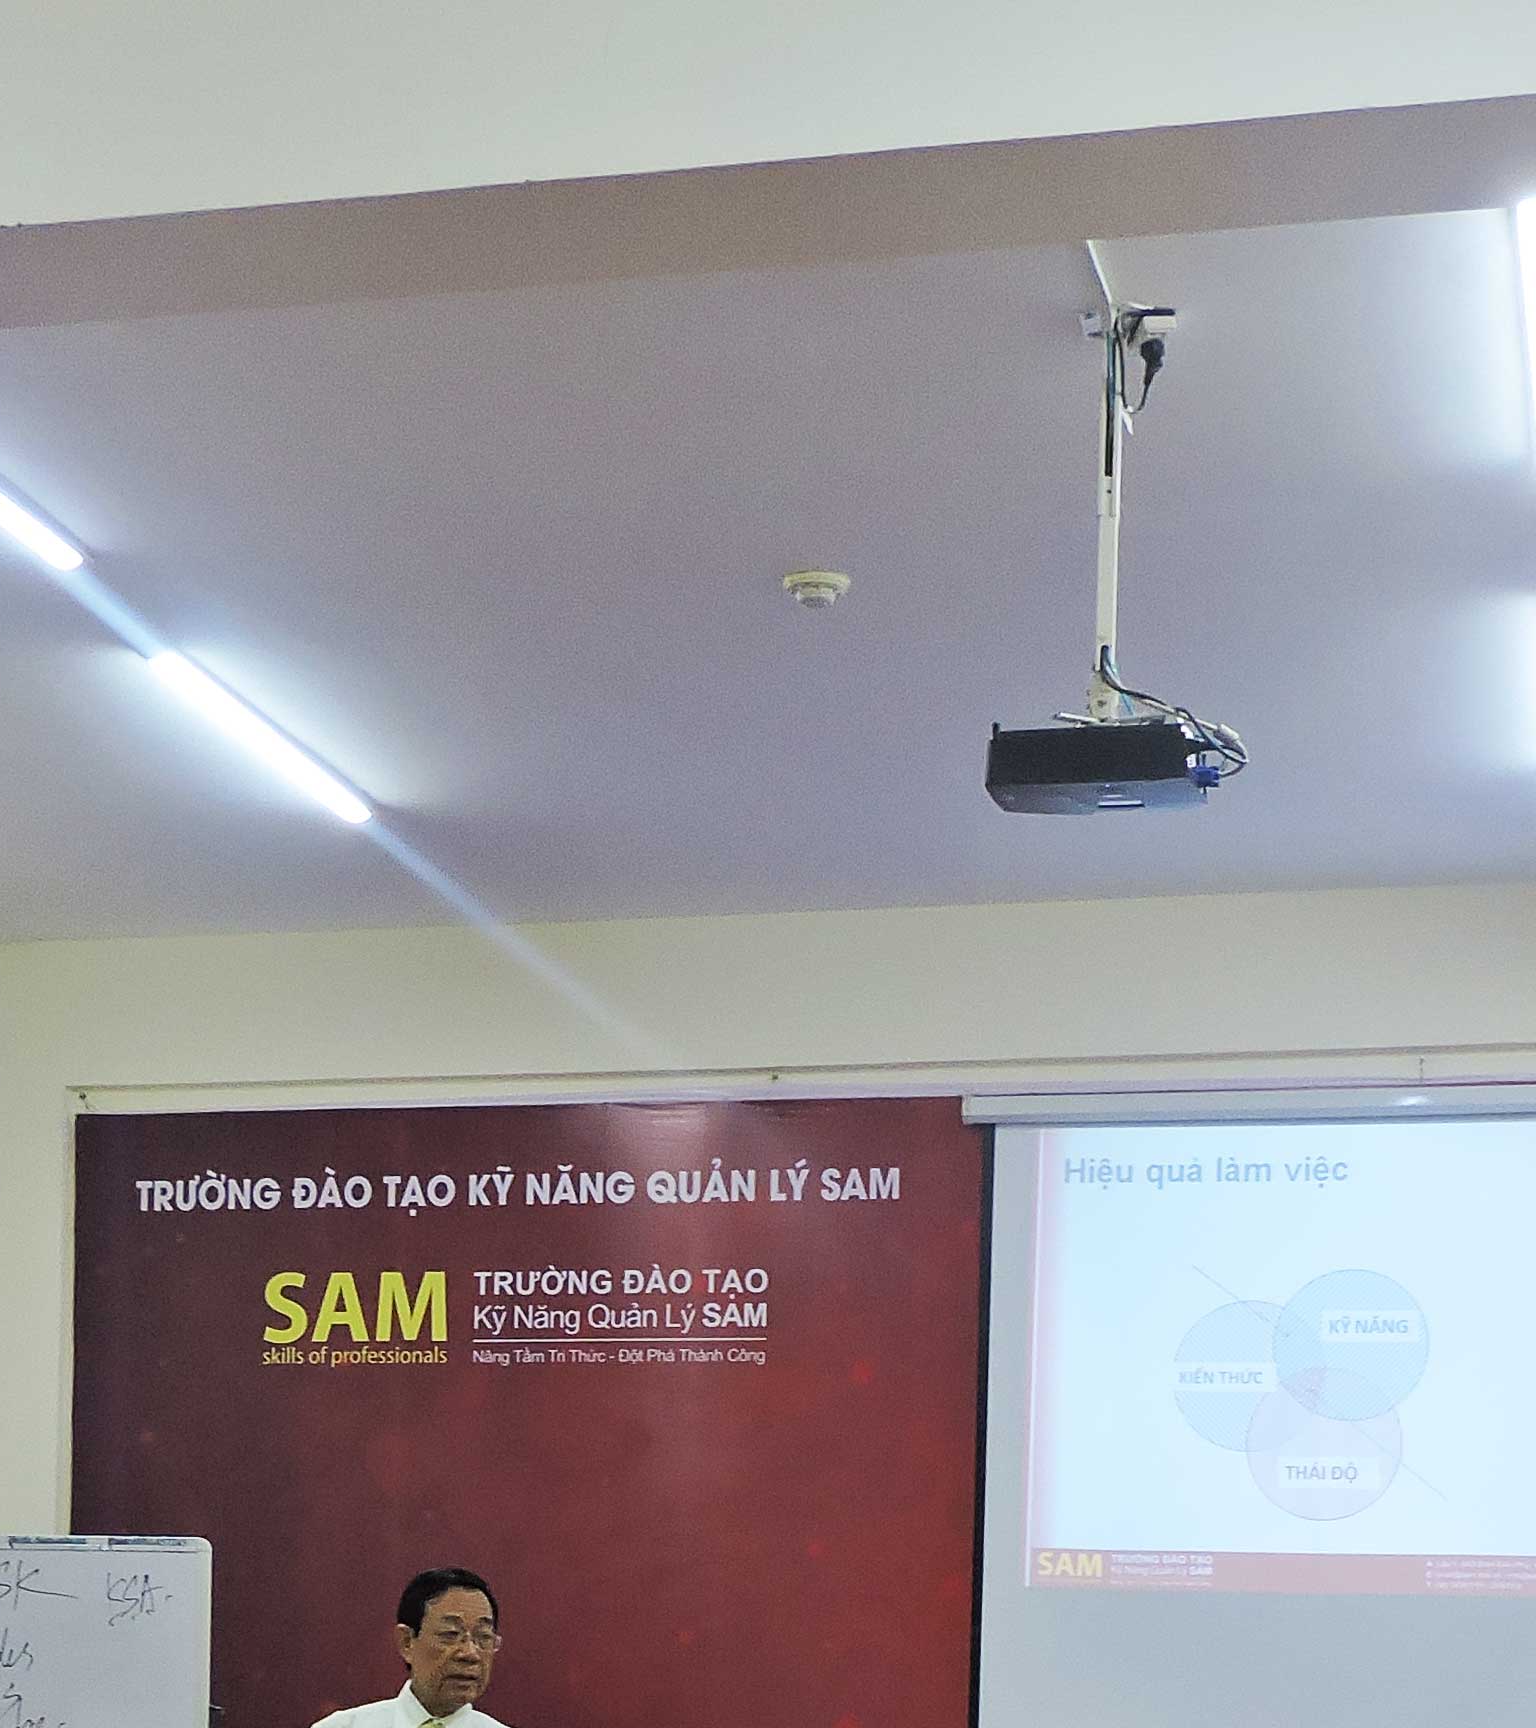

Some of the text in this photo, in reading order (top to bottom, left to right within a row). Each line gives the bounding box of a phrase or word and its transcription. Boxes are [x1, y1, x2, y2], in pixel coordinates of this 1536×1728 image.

[135, 1158, 901, 1217] TRƯỜNG ĐÀO TẠO KỸ NĂNG QUẢN LÝ SAM
[1064, 1155, 1349, 1190] Hiệu quả làm việc
[473, 1264, 769, 1300] TRƯỜNG ĐÀO TẠO
[263, 1271, 448, 1344] SAM
[473, 1302, 768, 1335] Kỹ Năng Quản Lý SAM
[1355, 1316, 1409, 1334] NĂNG
[262, 1346, 449, 1367] skills of professionals
[1285, 1462, 1326, 1481] THÁI
[1038, 1551, 1103, 1577] SAM
